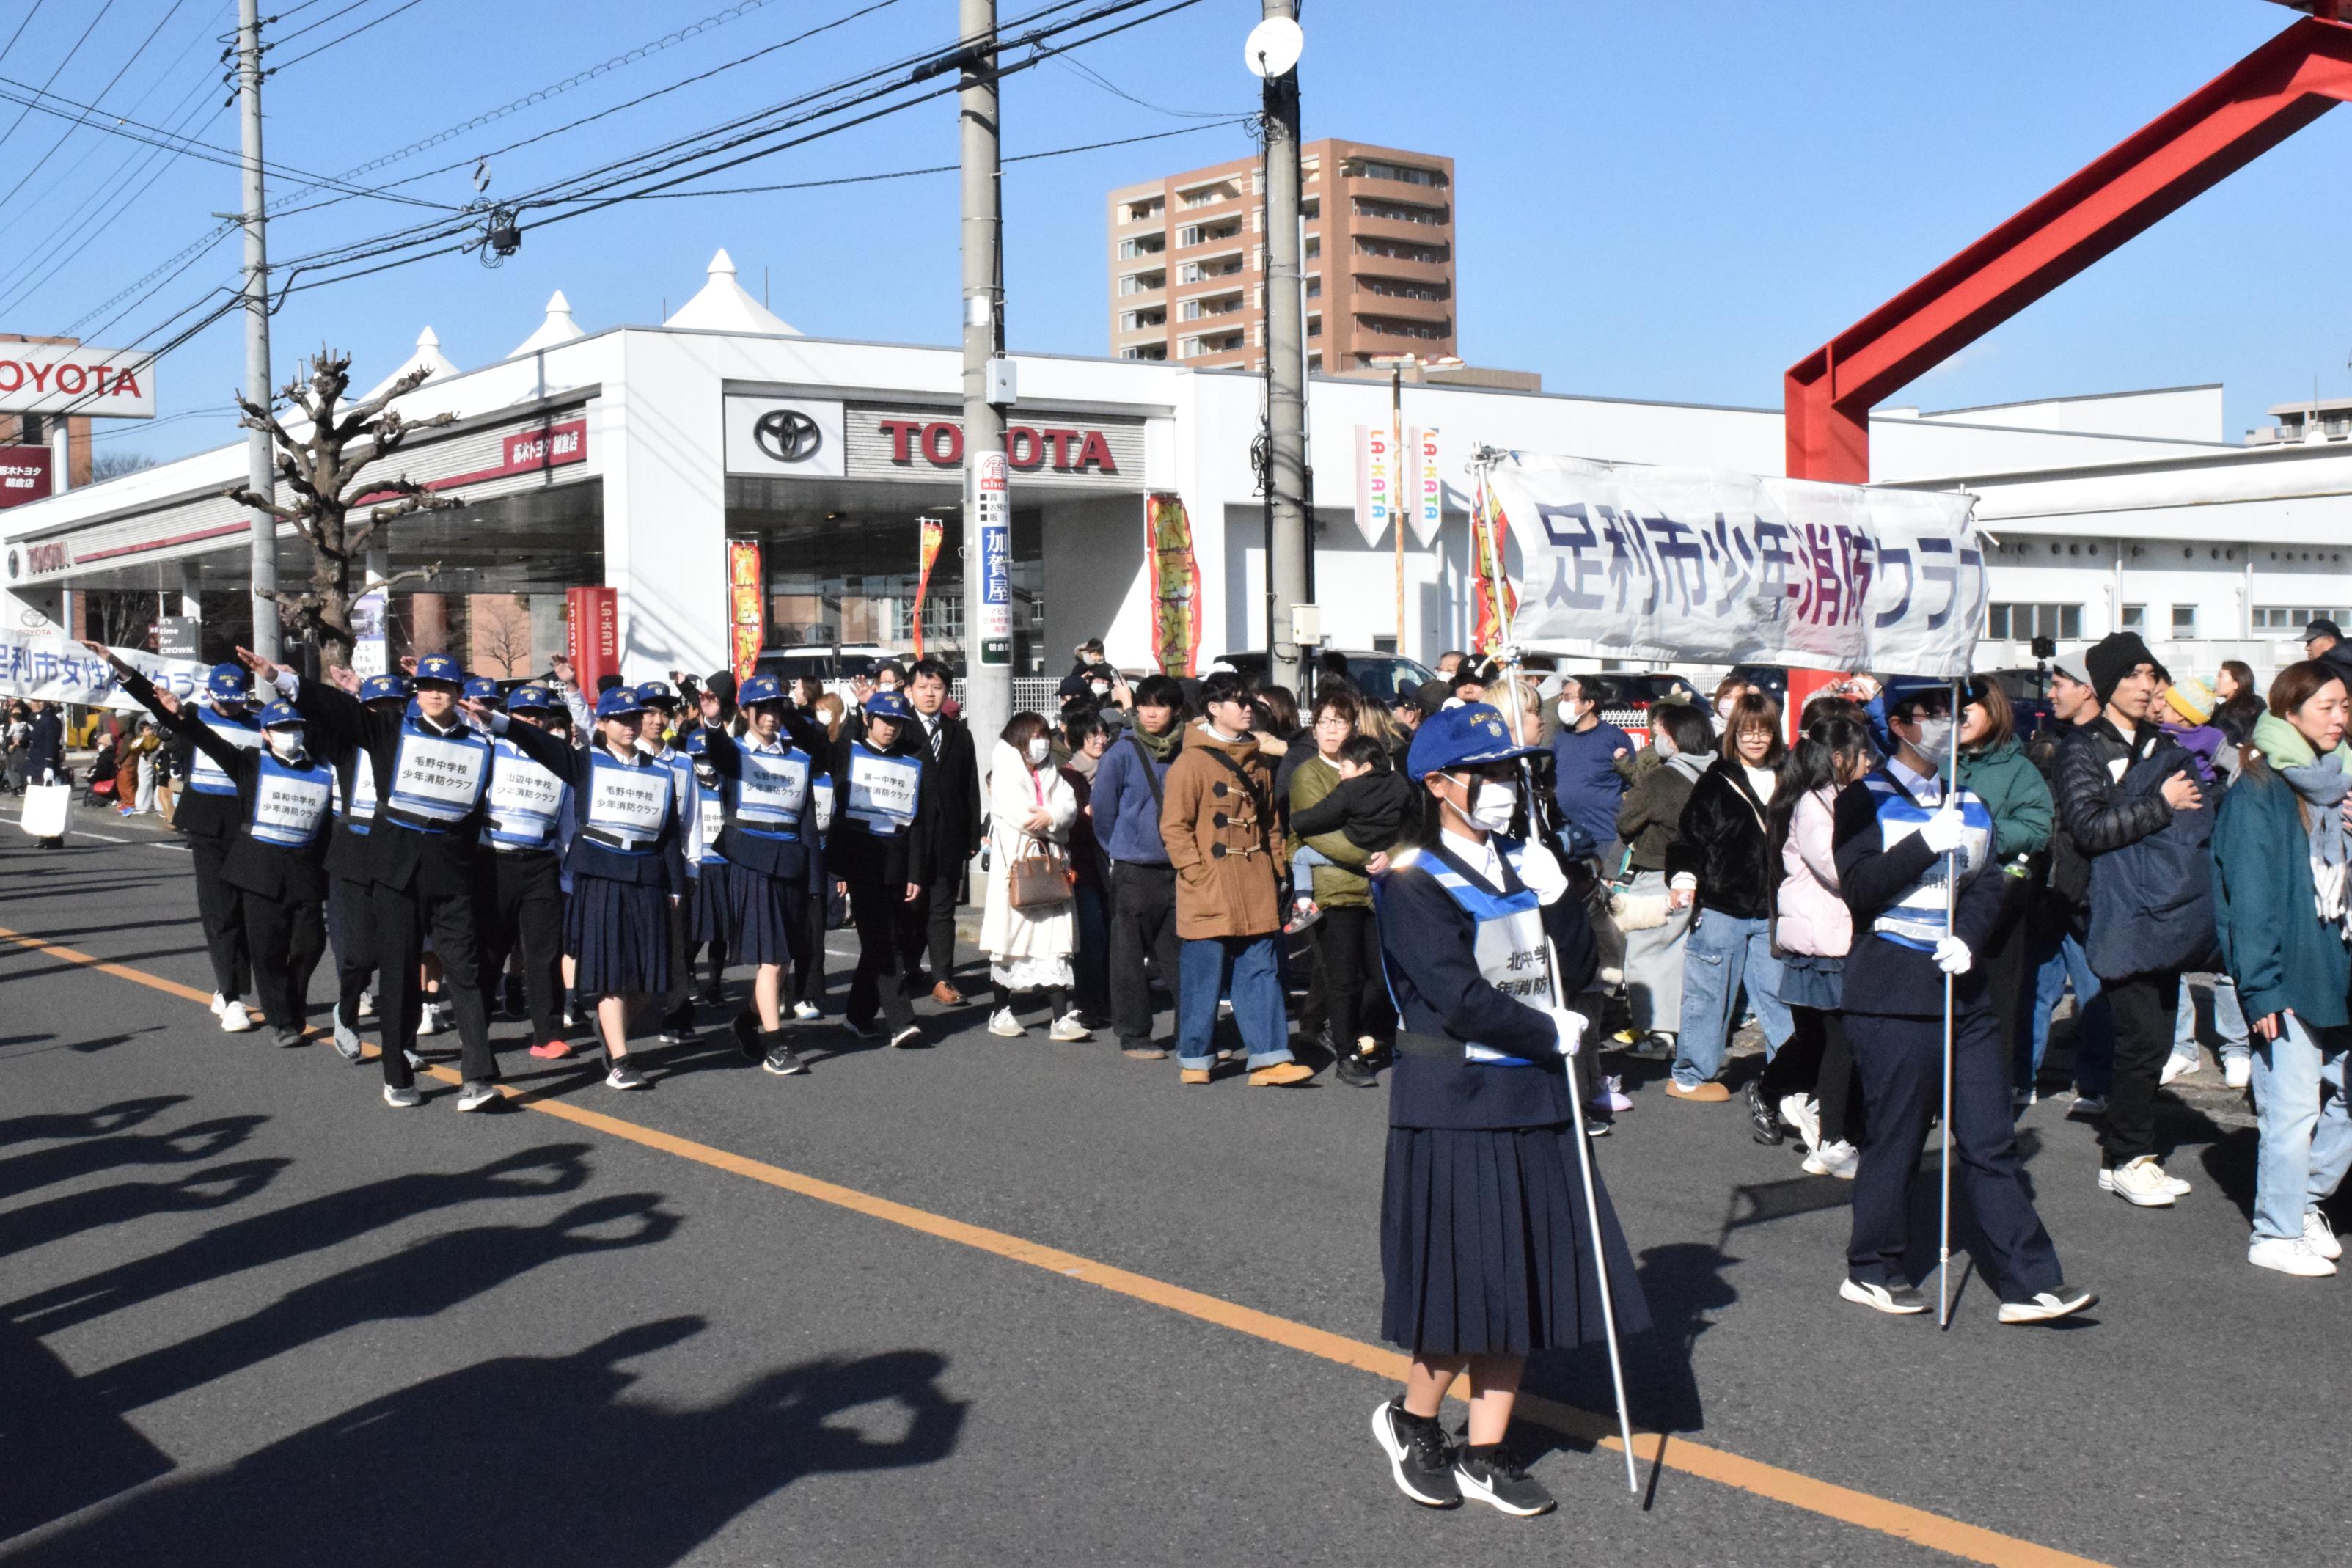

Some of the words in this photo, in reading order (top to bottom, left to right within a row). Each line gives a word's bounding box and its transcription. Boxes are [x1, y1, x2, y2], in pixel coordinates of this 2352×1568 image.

[880, 420, 1117, 470] TOOTA
[986, 530, 1008, 601] 加賀屋
[415, 756, 468, 774] 毛野中学校
[403, 769, 473, 790] 少年消防クラブ
[606, 785, 653, 802] 毛野中学校
[597, 799, 659, 815] 少年消防クラブ
